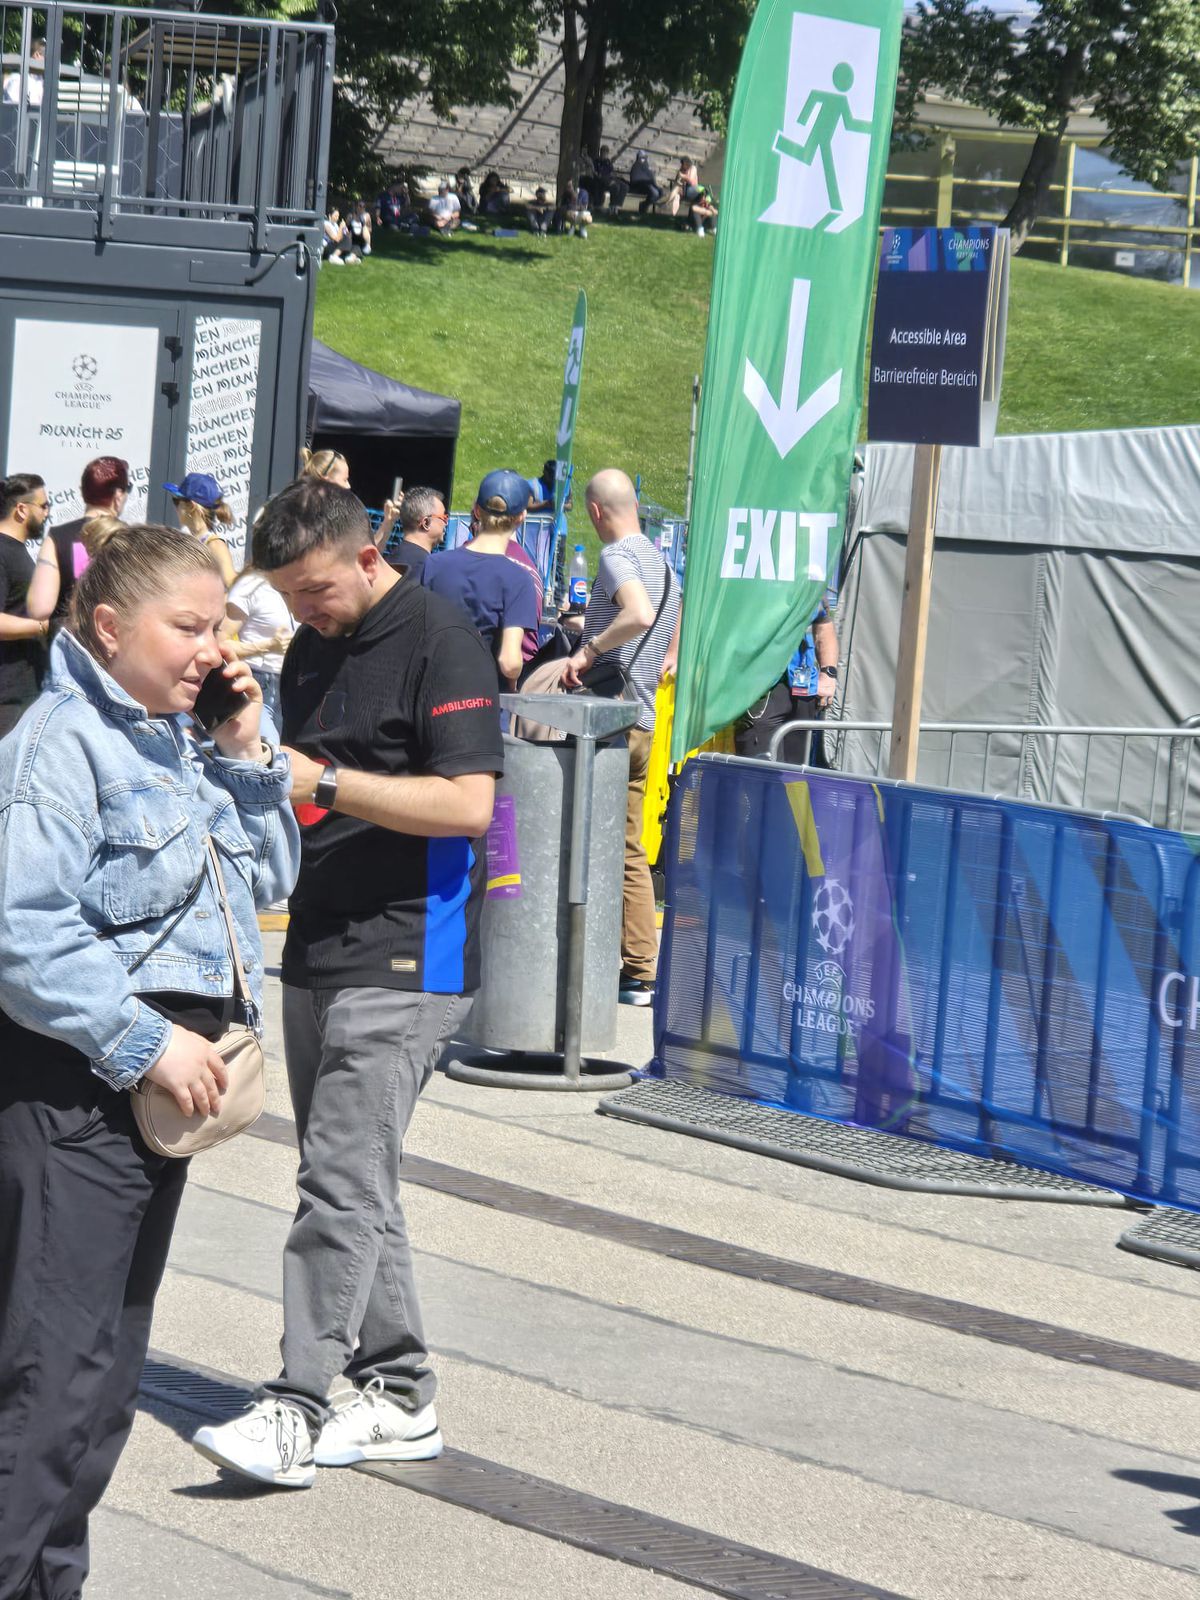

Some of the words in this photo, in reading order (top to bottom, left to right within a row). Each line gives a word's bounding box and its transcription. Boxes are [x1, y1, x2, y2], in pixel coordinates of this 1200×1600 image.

[948, 237, 990, 251] CHAMPIONS
[889, 328, 941, 345] Accessible
[943, 329, 967, 346] Area
[874, 366, 938, 385] Barrierefreier
[940, 369, 978, 387] Bereich
[55, 391, 112, 402] CHAMPIONS
[64, 400, 101, 409] LEAGUE
[105, 427, 124, 441] 25
[61, 441, 100, 450] FINAL
[720, 508, 838, 582] EXIT
[431, 697, 484, 717] AMBILIGHT
[783, 981, 876, 1019] CHAMPIONS
[797, 1007, 858, 1038] LEAGUE
